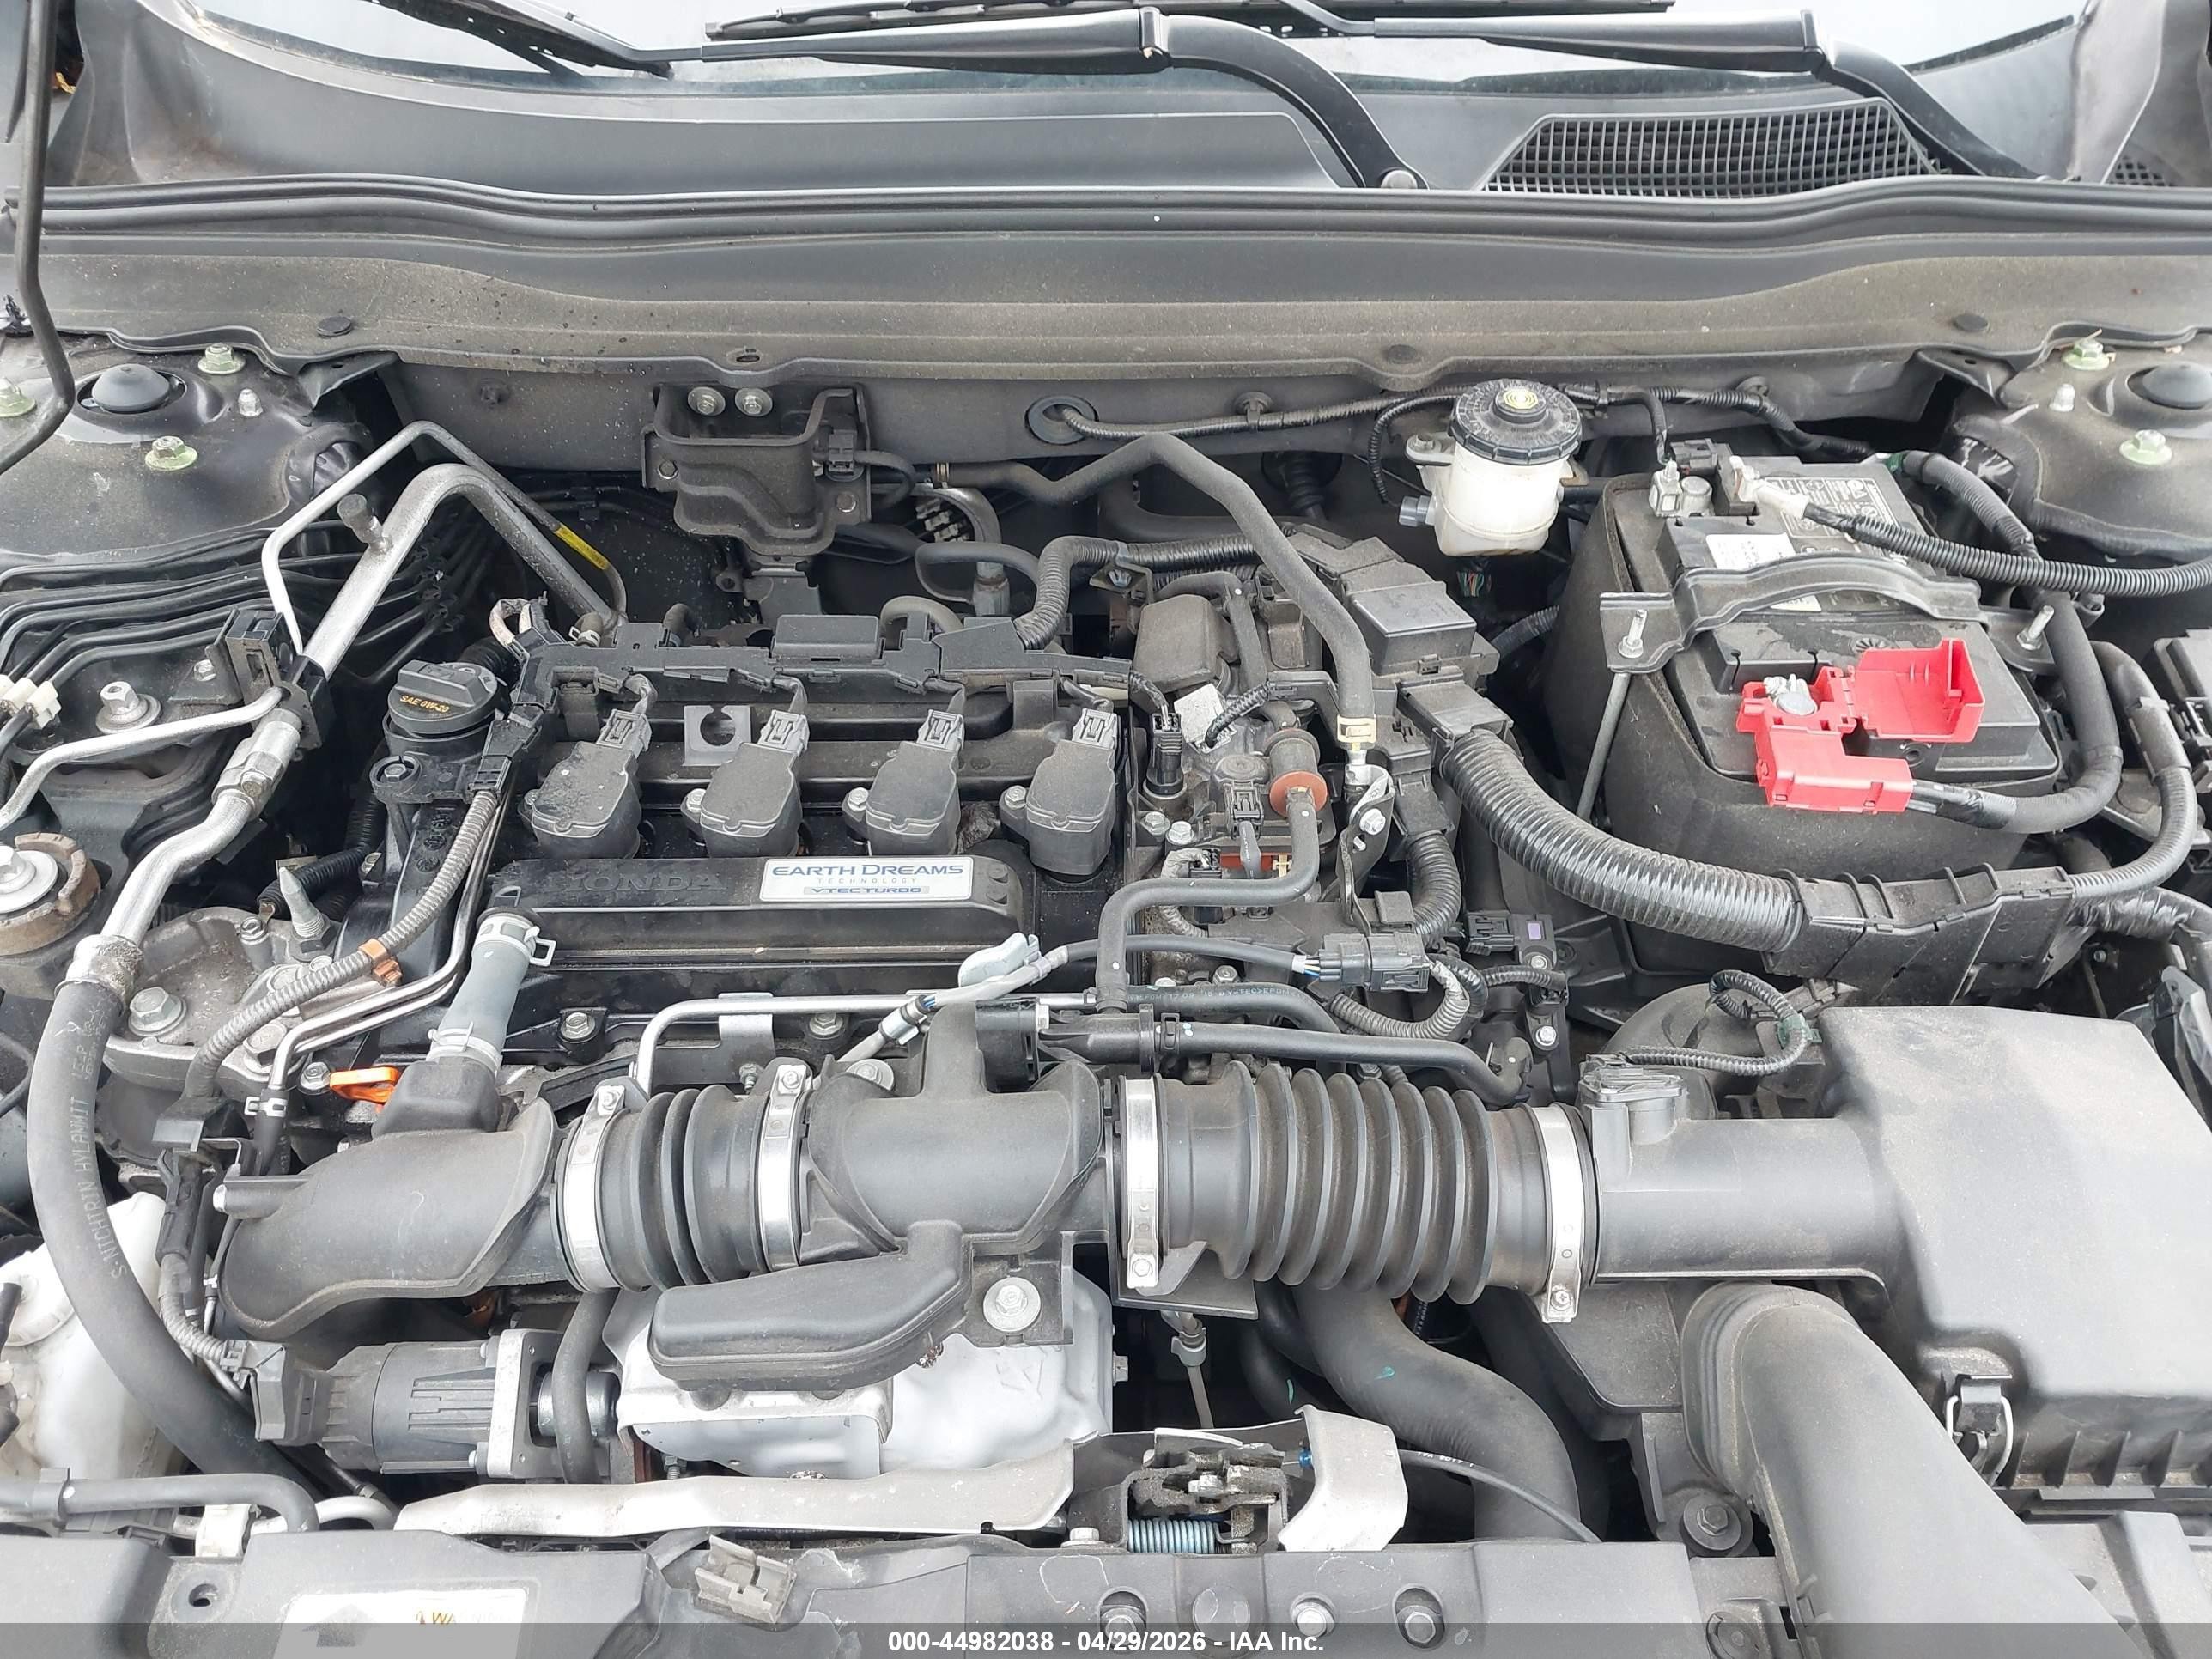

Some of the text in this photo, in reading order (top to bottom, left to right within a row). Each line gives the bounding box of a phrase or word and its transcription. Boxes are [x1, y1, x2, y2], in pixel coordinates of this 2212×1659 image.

[399, 695, 450, 713] SAE 0W-20
[771, 864, 964, 877] EARTH DREAMS
[543, 874, 728, 892] HONDA
[69, 1096, 93, 1174] HYLAMMIT
